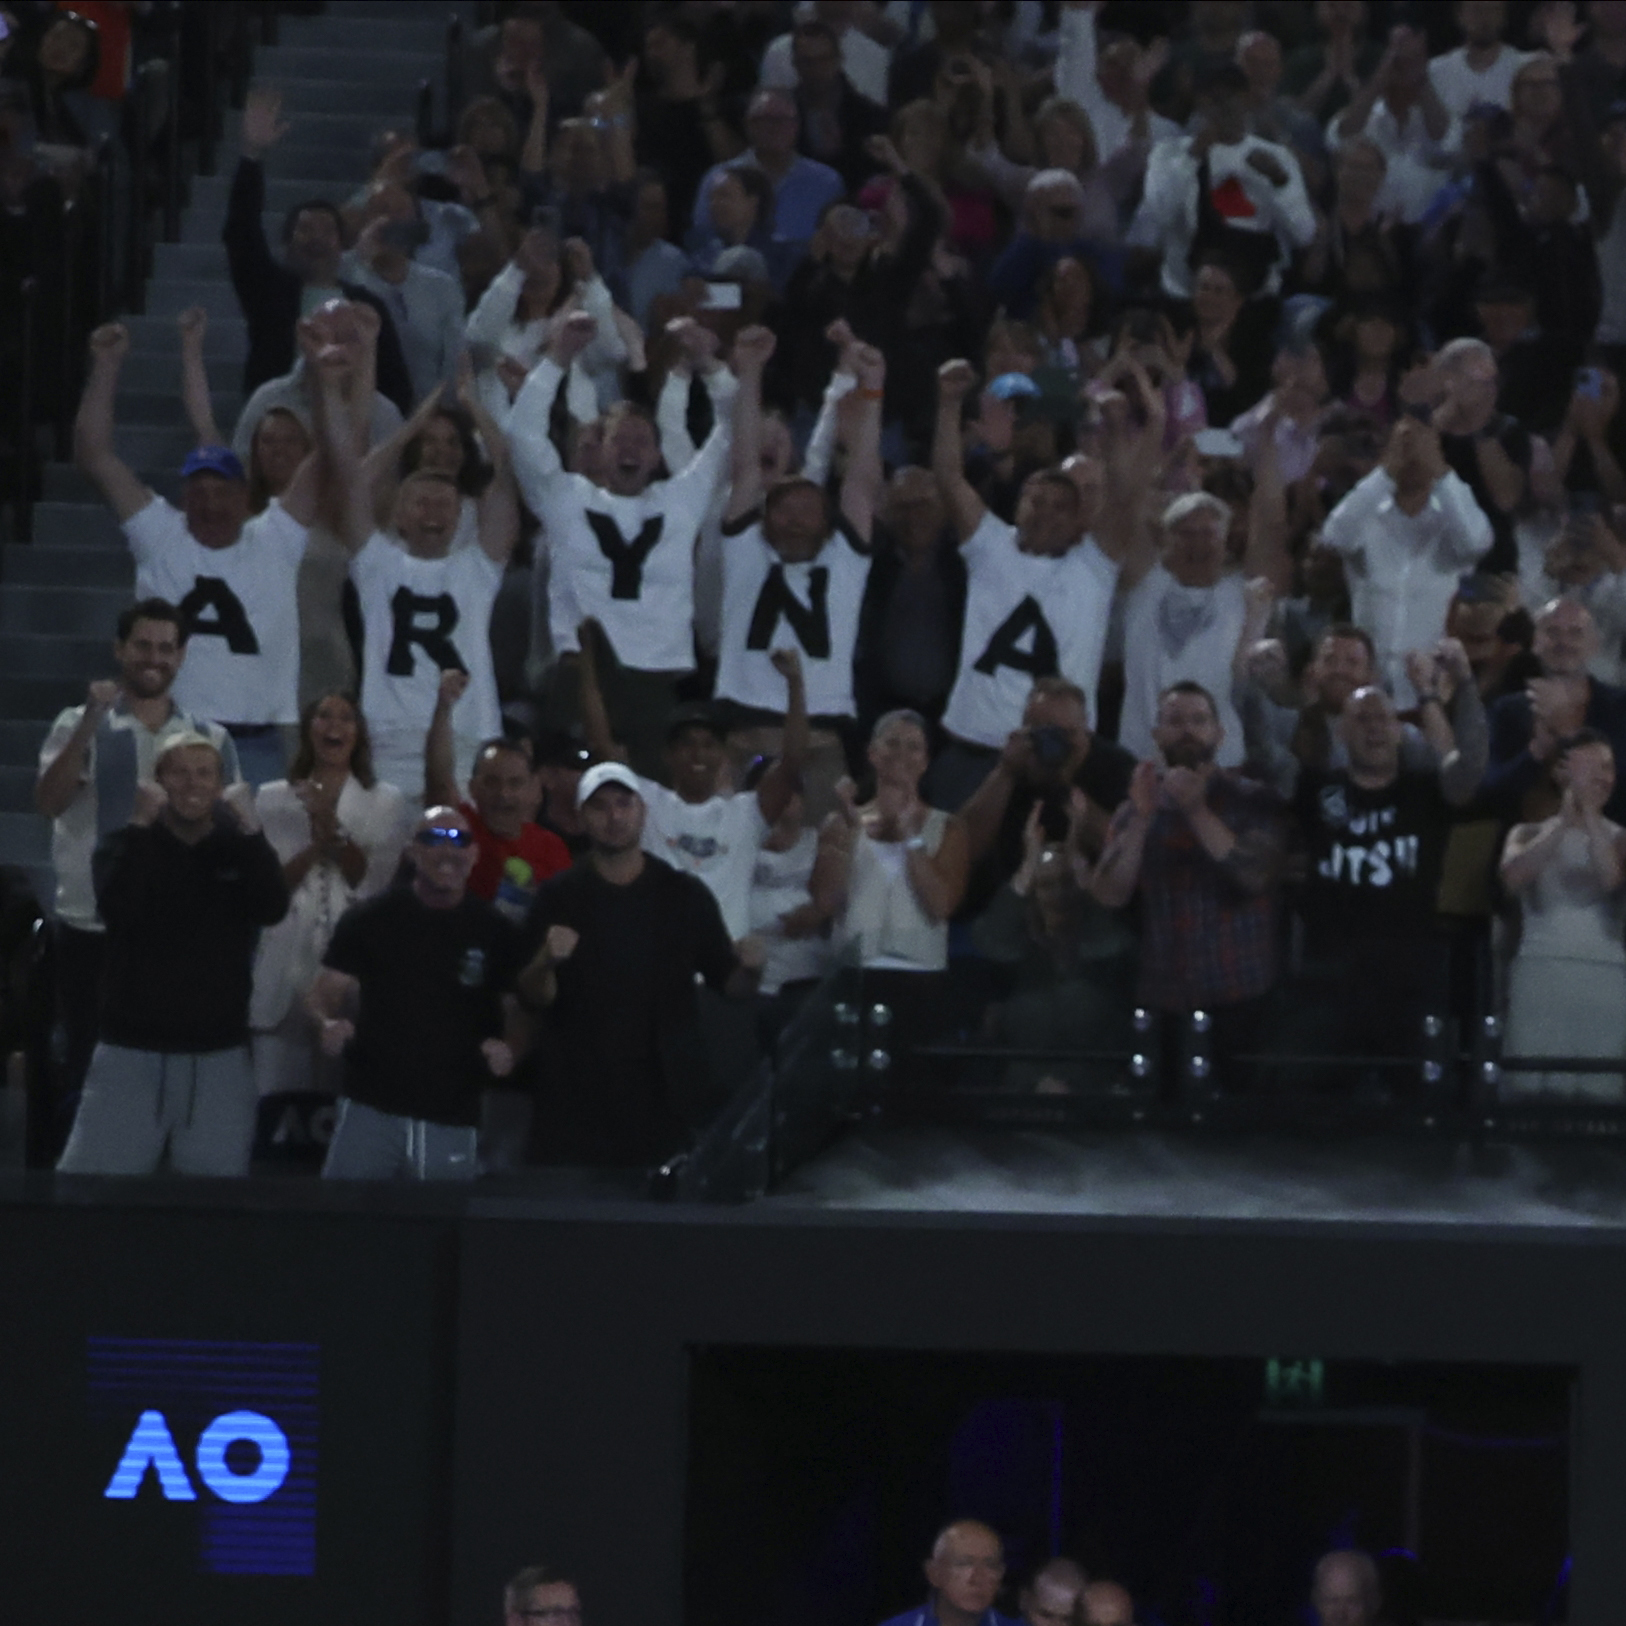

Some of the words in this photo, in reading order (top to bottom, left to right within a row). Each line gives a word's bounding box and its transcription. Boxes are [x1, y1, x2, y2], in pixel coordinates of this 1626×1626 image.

[586, 511, 663, 600] Y
[180, 576, 260, 656] A
[386, 586, 468, 677] R
[747, 564, 831, 660] N
[974, 596, 1061, 679] A
[105, 1411, 291, 1502] AO
